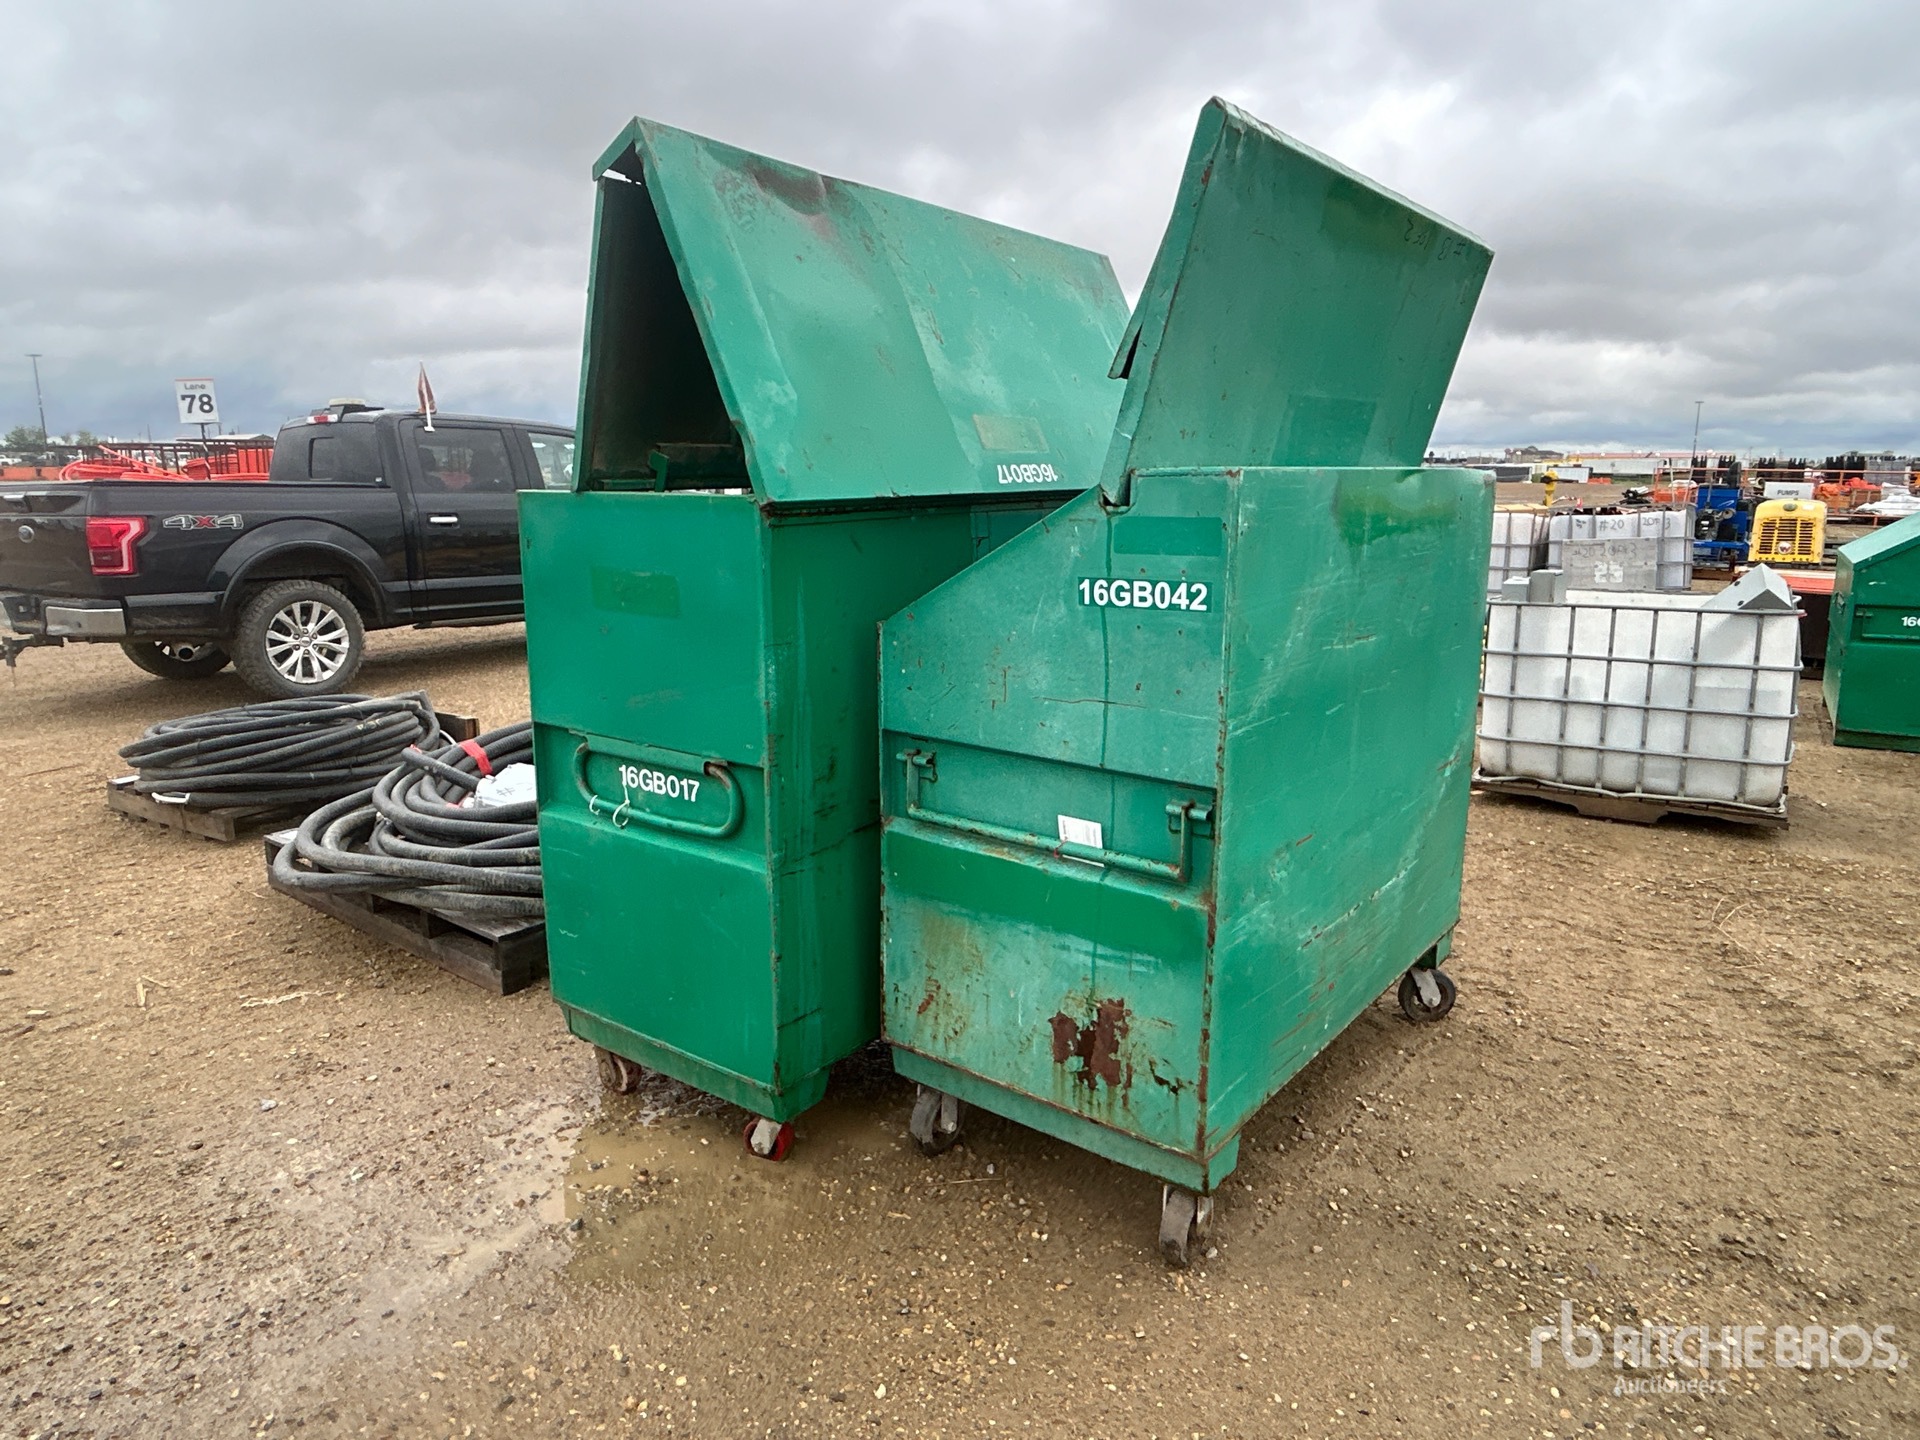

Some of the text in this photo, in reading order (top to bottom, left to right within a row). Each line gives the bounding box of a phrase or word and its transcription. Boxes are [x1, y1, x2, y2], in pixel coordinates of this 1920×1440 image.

[180, 393, 214, 414] 78
[996, 463, 1059, 484] 16GB017
[1079, 578, 1208, 611] 16GB042
[618, 764, 700, 802] 16GB017
